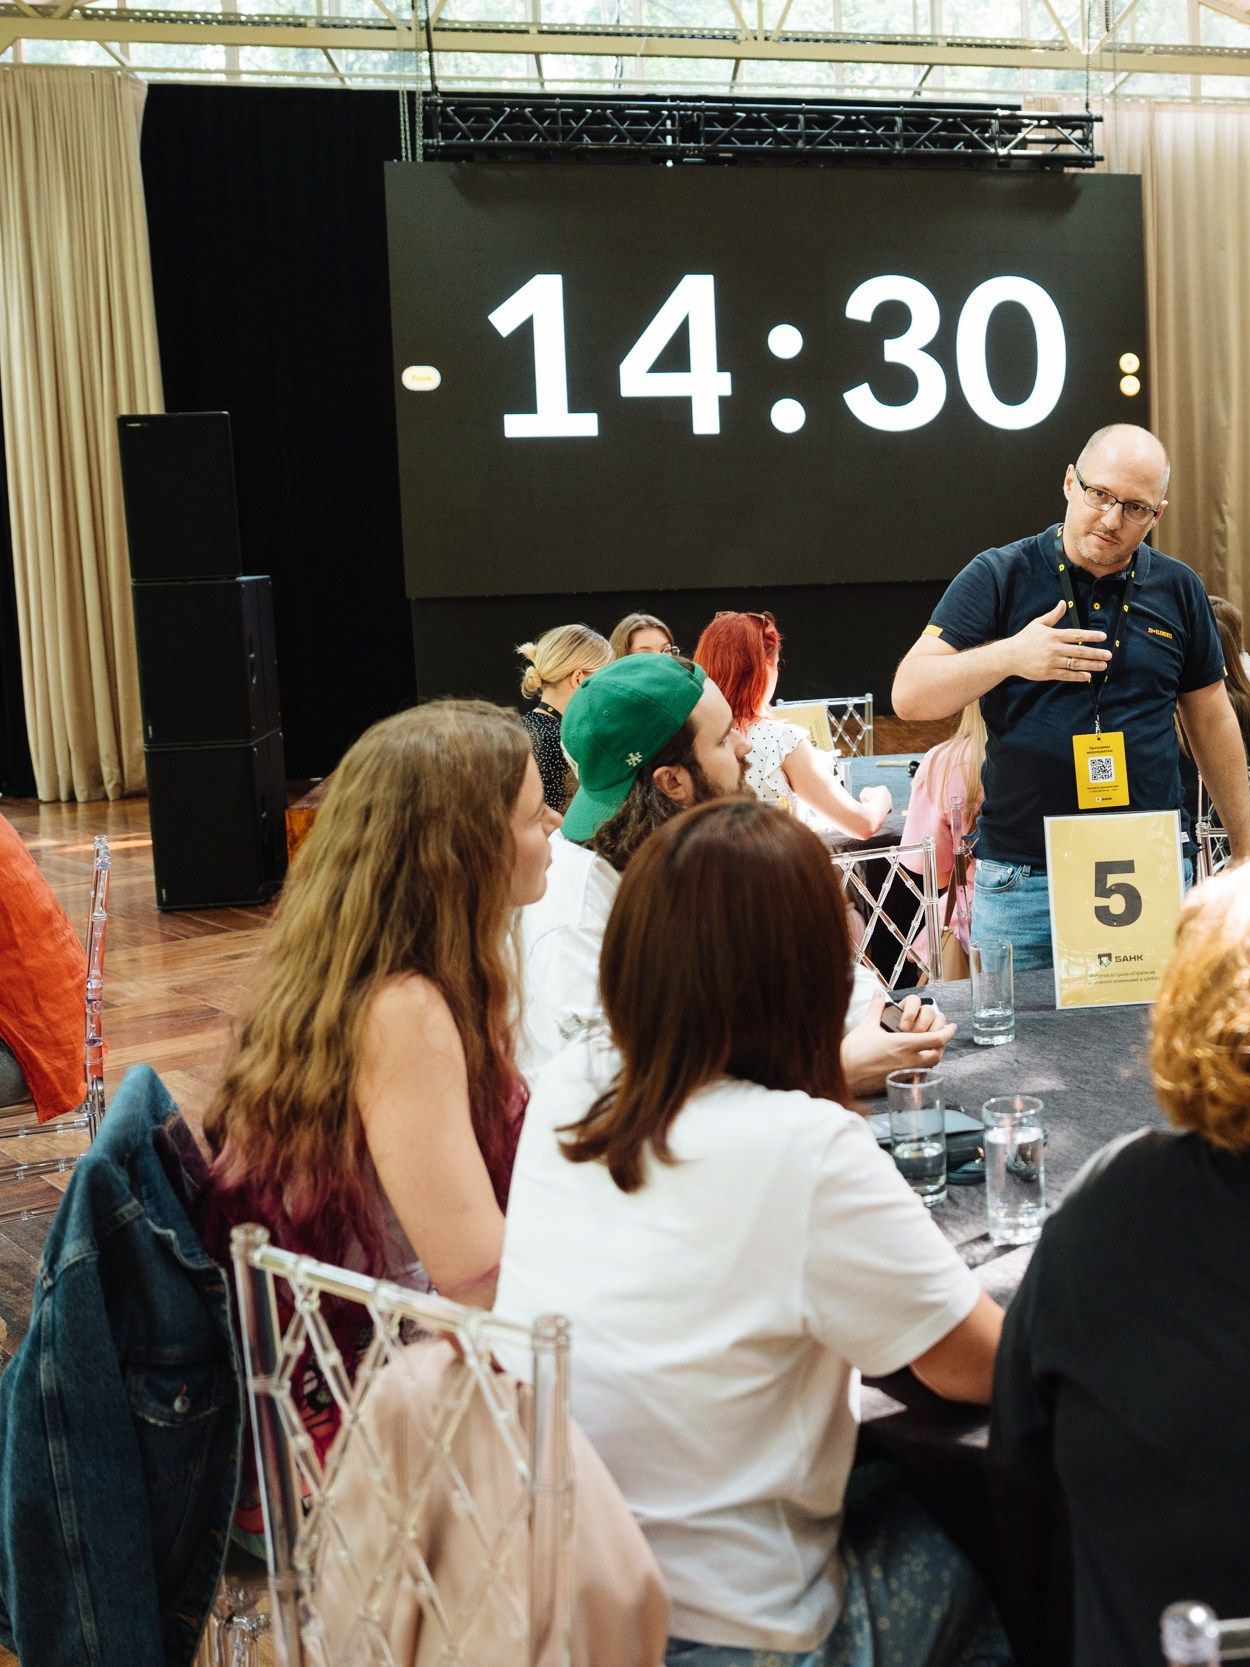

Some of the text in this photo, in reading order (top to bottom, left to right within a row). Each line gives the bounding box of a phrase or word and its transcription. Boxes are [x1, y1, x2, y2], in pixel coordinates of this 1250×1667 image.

[487, 274, 1067, 438] 14:30
[1094, 859, 1143, 928] 5
[1114, 954, 1144, 963] БАНК
